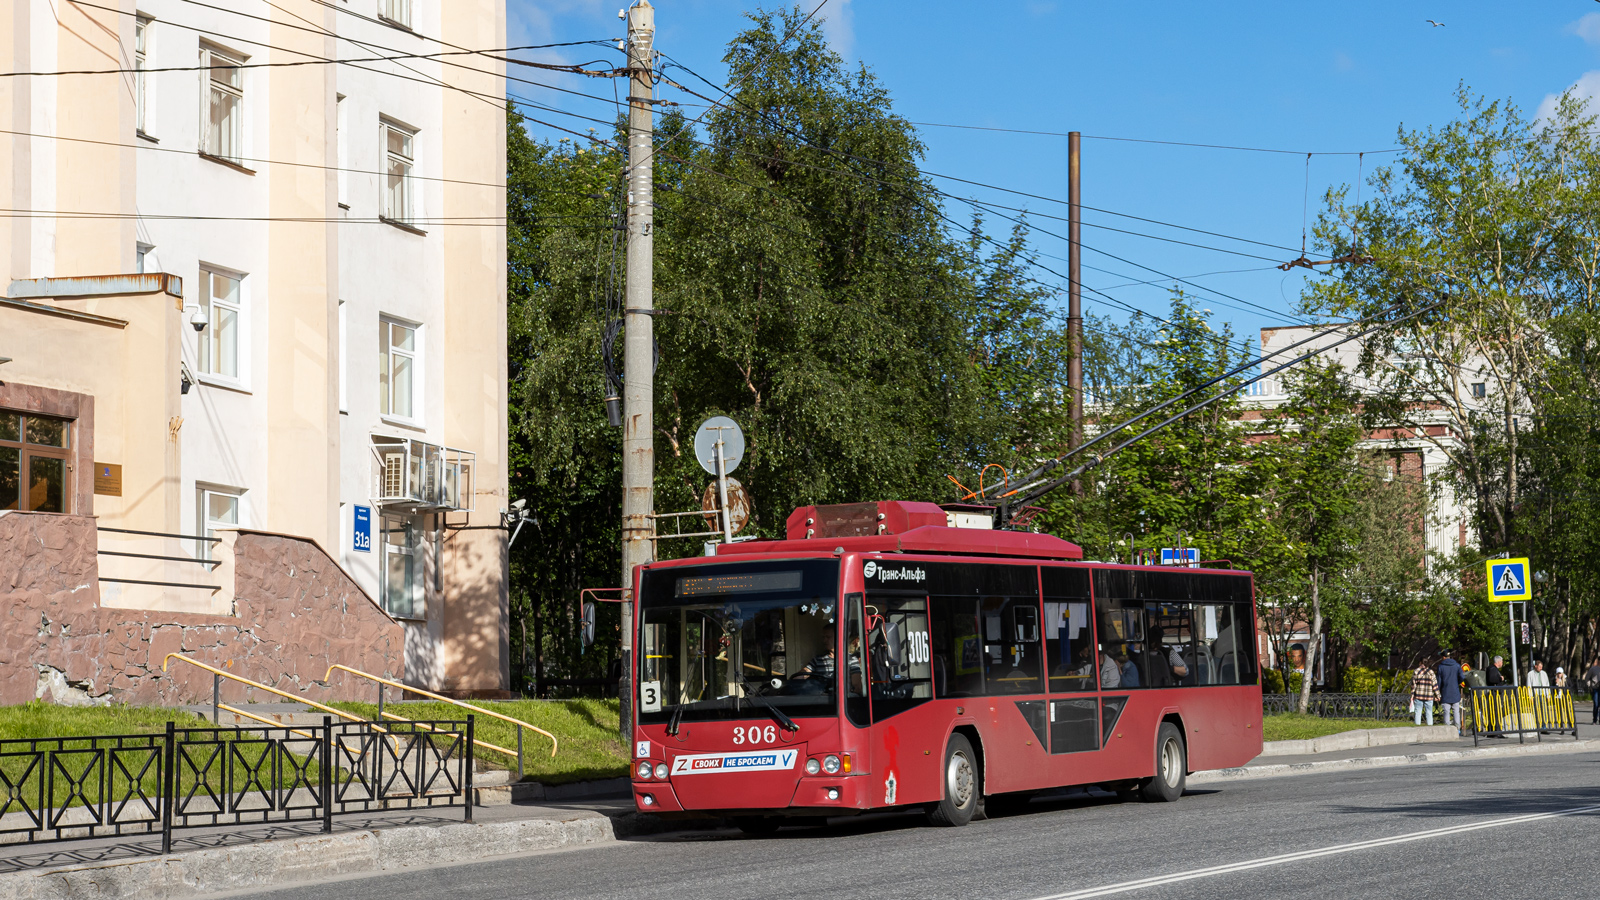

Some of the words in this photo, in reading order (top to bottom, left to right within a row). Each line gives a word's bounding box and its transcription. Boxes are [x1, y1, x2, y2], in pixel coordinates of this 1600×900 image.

[355, 531, 370, 548] 31а
[877, 566, 926, 583] Транс-Альфа
[908, 631, 929, 663] 306
[645, 687, 657, 705] 3
[733, 725, 776, 744] 306
[677, 759, 687, 772] Z
[694, 759, 720, 768] СВОИХ
[726, 758, 736, 766] НЕ
[737, 756, 773, 766] БРОСАЕМ
[782, 752, 793, 767] V
